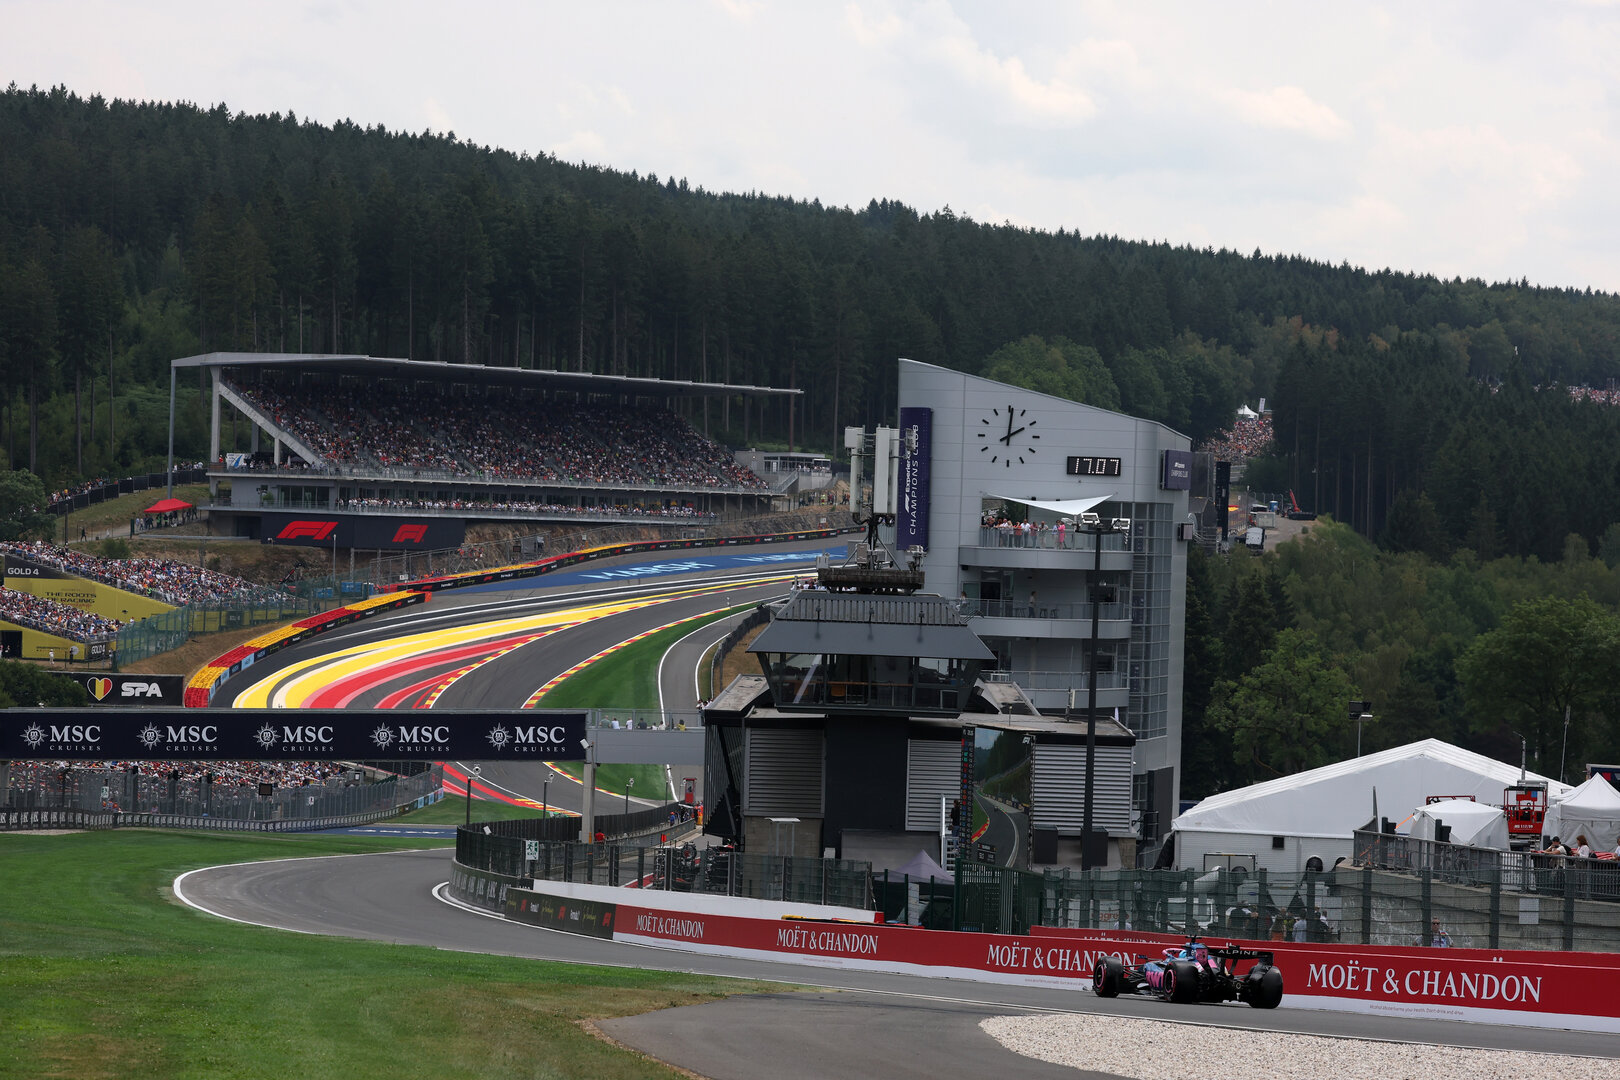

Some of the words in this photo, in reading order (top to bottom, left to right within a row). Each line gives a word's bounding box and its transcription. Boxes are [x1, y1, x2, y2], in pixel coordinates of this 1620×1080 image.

[910, 460, 919, 535] CHAMPIONS
[33, 568, 39, 576] 4
[121, 682, 163, 697] SPA
[50, 726, 100, 742] MSC
[166, 726, 217, 743] MSC
[283, 726, 333, 743] MSC
[399, 726, 449, 743] MSC
[515, 727, 565, 743] MSC
[636, 912, 658, 932] MOËT
[658, 920, 664, 934] &
[664, 918, 704, 939] CHANDON
[777, 926, 809, 948] MOËT
[809, 931, 817, 949] &
[818, 932, 878, 954] CHANDON
[987, 942, 1031, 967] MOËT
[1033, 947, 1044, 968] &
[1307, 960, 1379, 992] MOËT
[1383, 969, 1399, 994] &
[1404, 970, 1542, 1003] CHANDON
